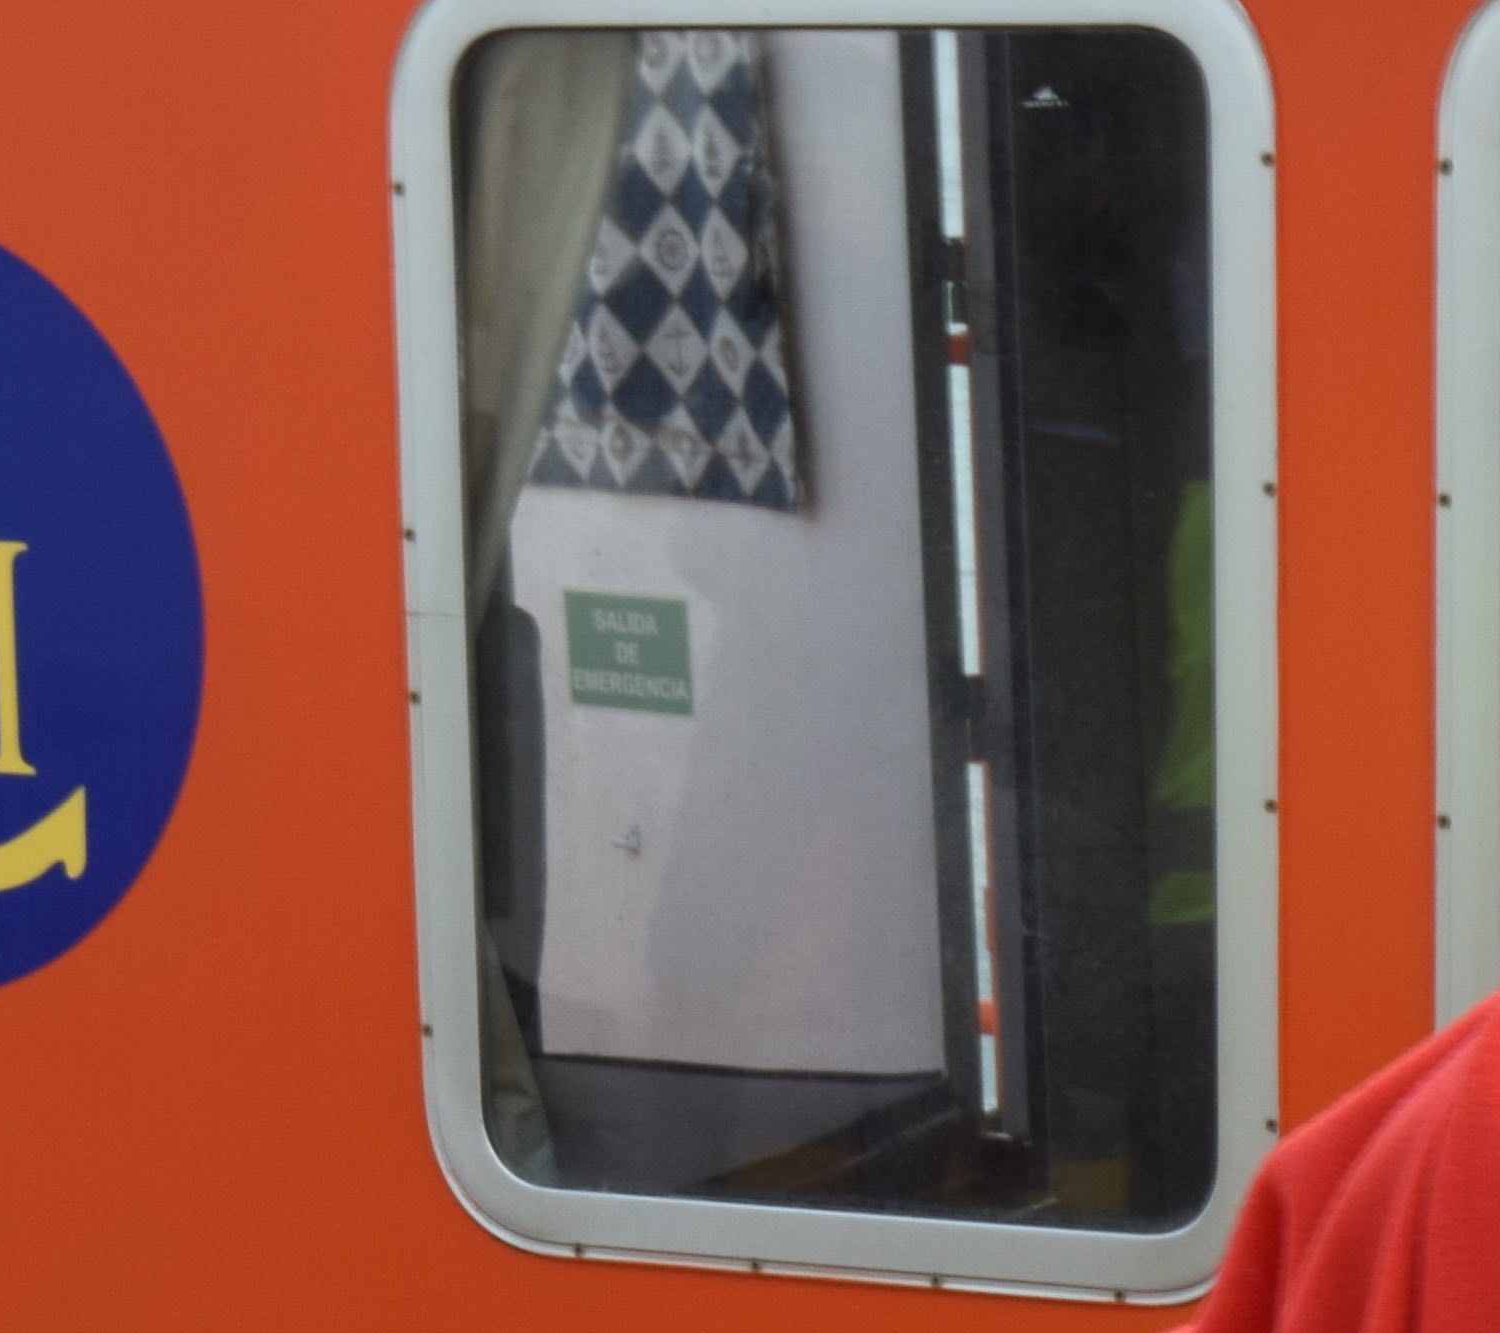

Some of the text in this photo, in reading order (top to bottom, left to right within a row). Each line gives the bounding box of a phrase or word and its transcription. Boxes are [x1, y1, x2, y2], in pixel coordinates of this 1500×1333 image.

[593, 609, 660, 635] SALIDA
[615, 640, 640, 664] DE
[573, 668, 689, 700] EMERGENCIA
